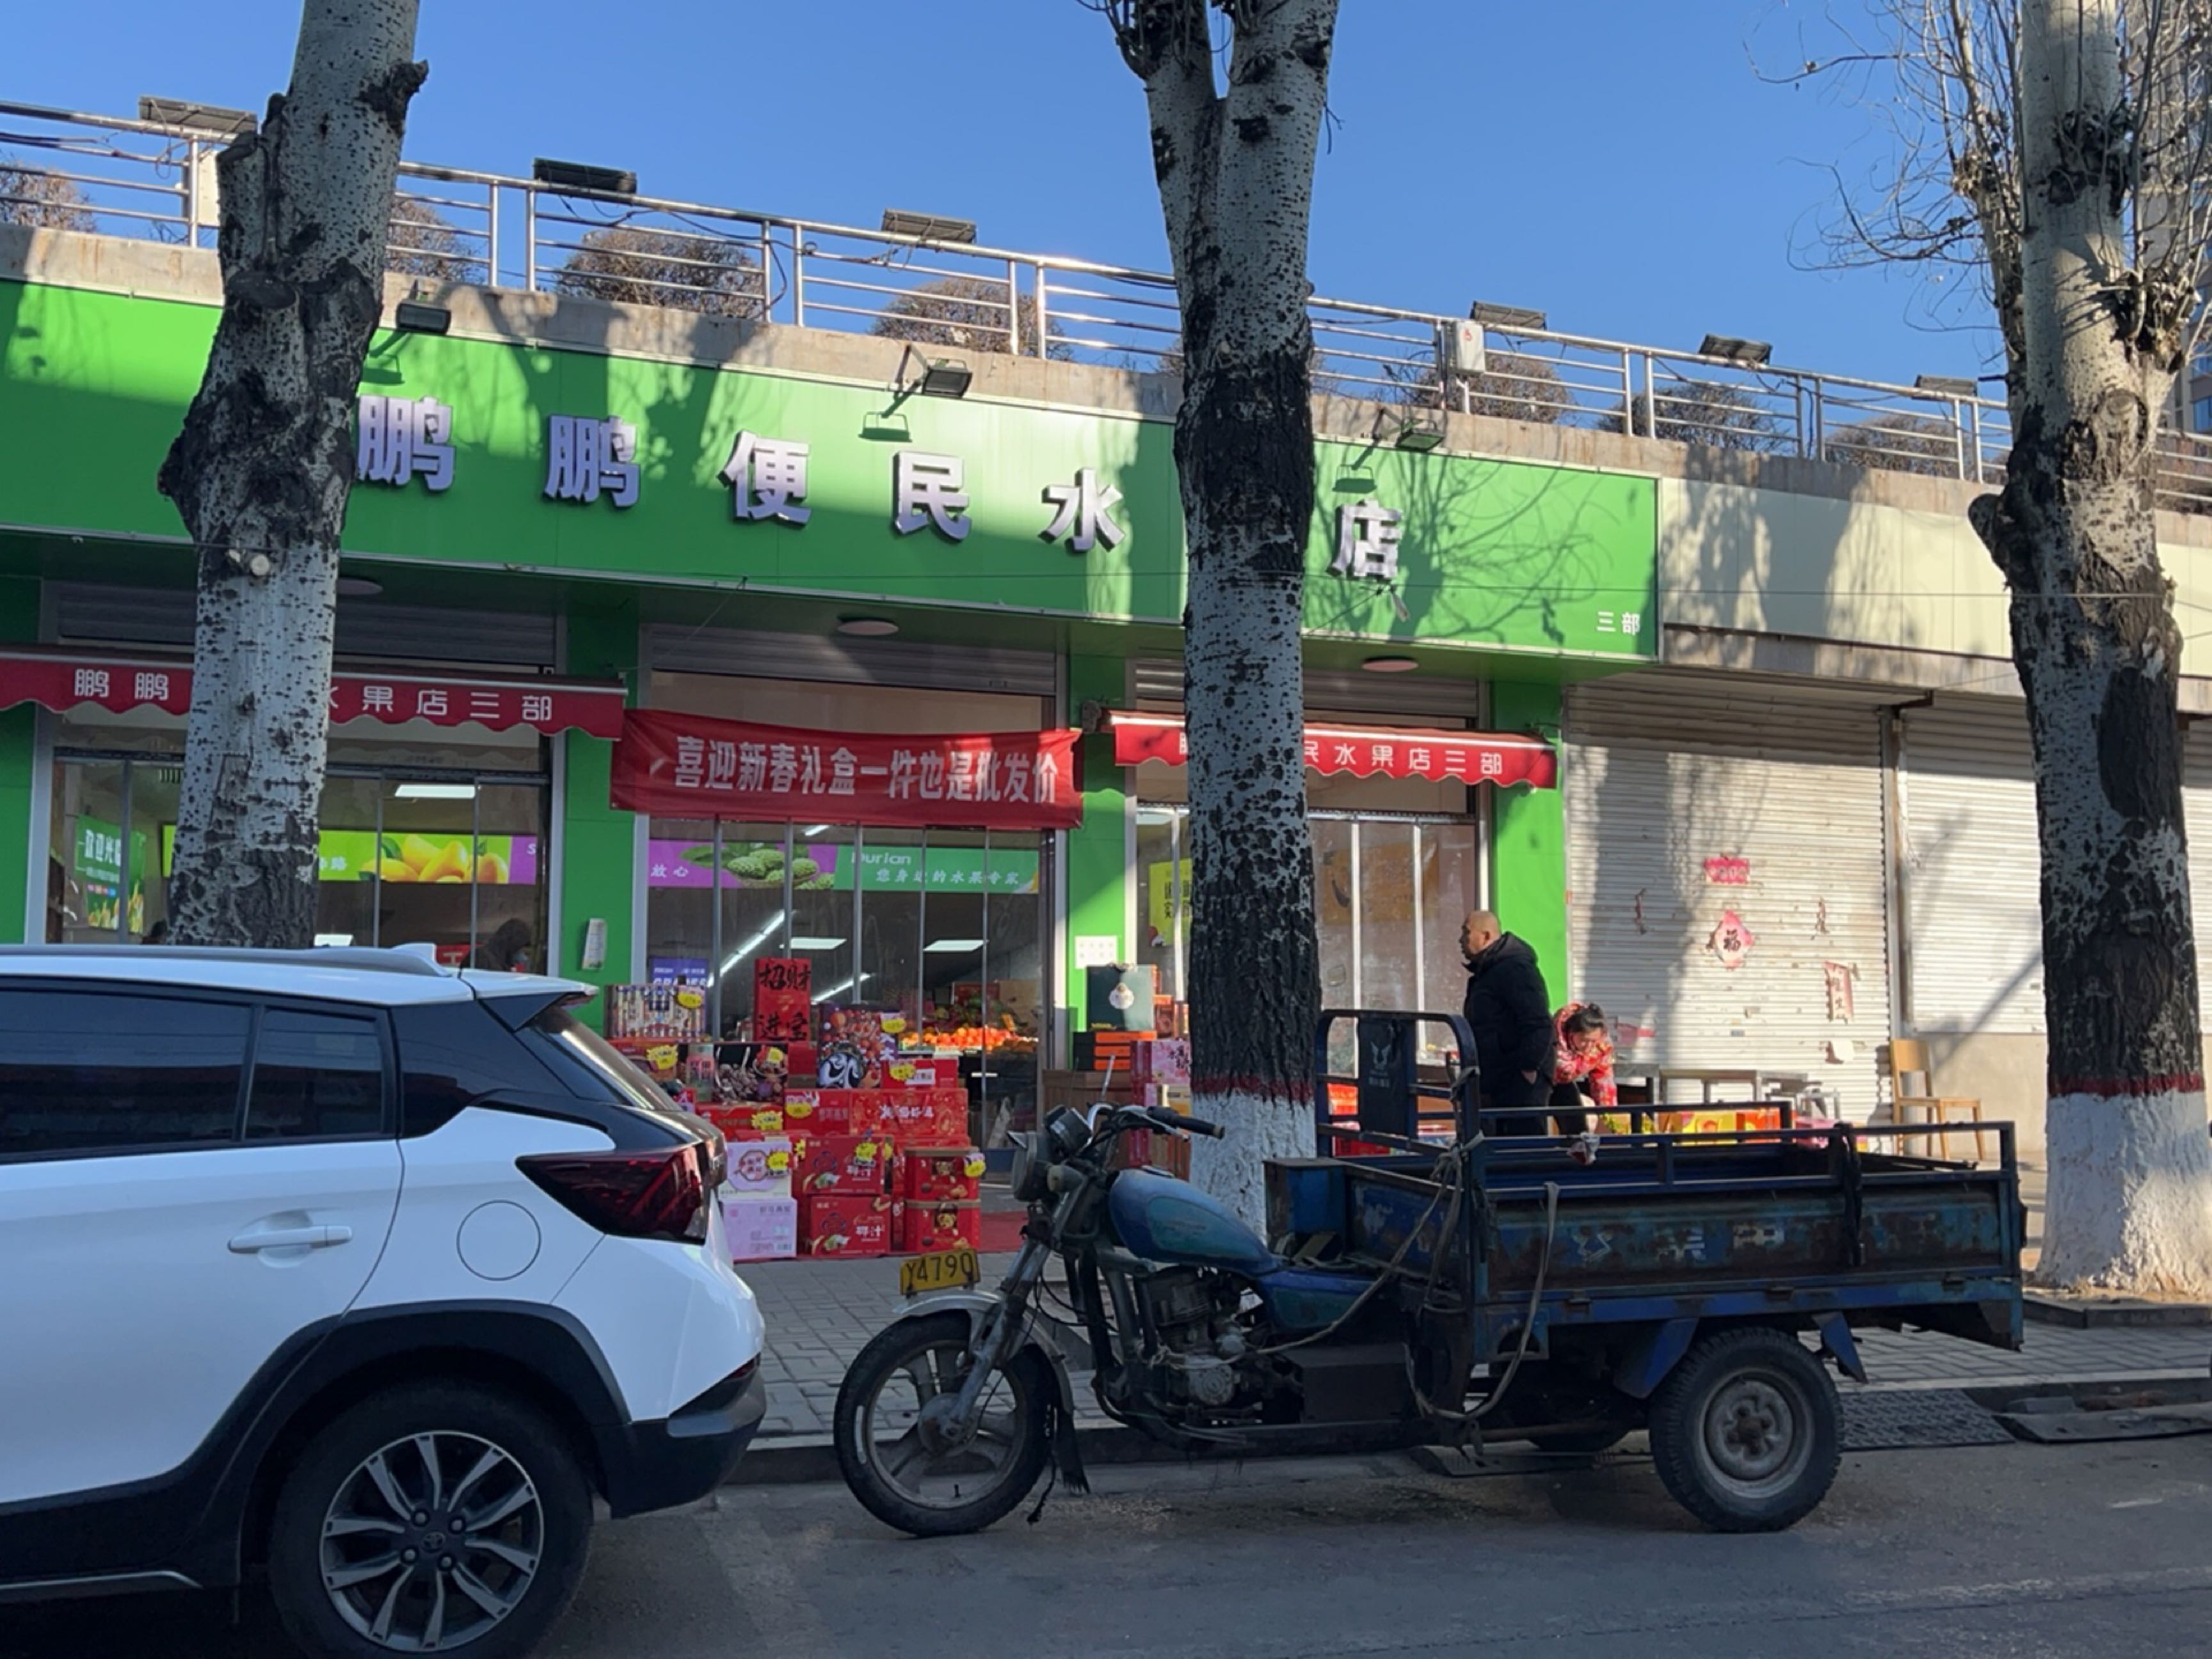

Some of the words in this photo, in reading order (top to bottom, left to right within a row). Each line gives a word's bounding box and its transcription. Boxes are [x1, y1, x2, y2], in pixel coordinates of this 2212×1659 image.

[1596, 610, 1640, 636] 三部
[674, 734, 1059, 805] 喜迎新春礼盒一件也是批发价
[650, 863, 689, 879] 放心
[1722, 928, 1742, 953] 福
[758, 963, 812, 991] 招财
[758, 1011, 808, 1042] 进宝
